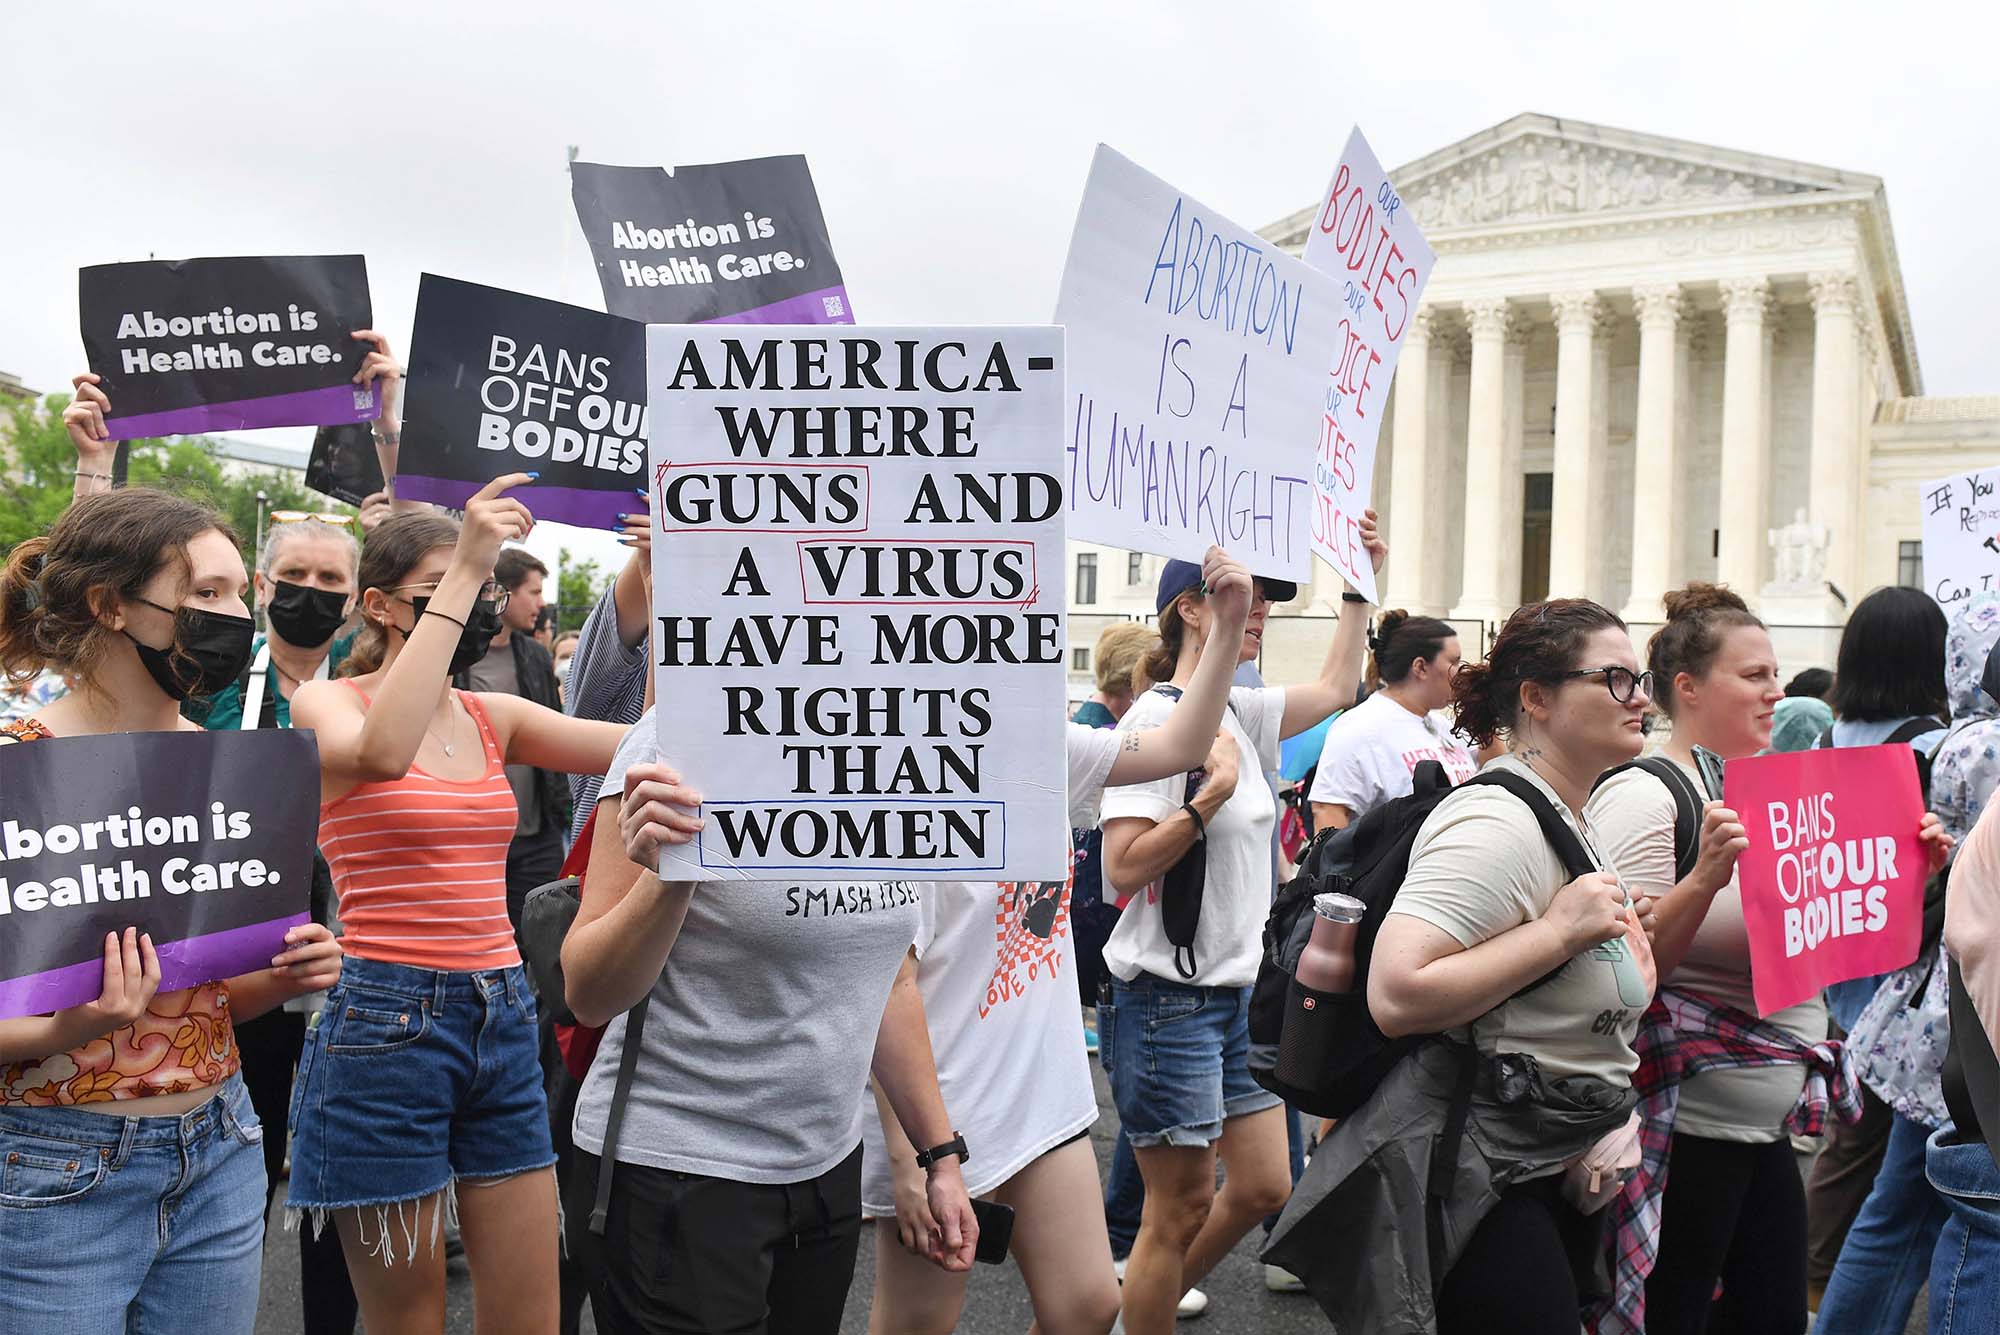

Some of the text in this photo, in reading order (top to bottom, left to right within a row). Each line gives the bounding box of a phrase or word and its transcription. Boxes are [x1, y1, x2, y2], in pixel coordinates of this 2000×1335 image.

[1377, 181, 1400, 225] OUR
[611, 211, 775, 251] Abortion is
[1320, 164, 1417, 342] BODIES
[618, 248, 805, 288] Health Care.
[1144, 197, 1303, 355] ABORTION
[116, 303, 318, 340] Abortion is
[120, 337, 343, 375] Health Care.
[488, 334, 611, 393] BANS
[1156, 333, 1248, 439] IS A
[477, 412, 646, 475] BODIES
[715, 406, 979, 458] WHERE
[665, 472, 1063, 525] GUNS AND
[1966, 474, 1994, 505] You
[721, 546, 1024, 600] A VIRUS
[658, 612, 1063, 667] HAVE MORE
[722, 686, 992, 737] RIGHTS
[782, 744, 985, 795] THAN
[0, 801, 252, 861] bortion is
[711, 808, 991, 859] WOMEN
[1767, 791, 1836, 851] BANS
[161, 857, 281, 895] Care.
[785, 885, 873, 918] SMASH
[1783, 884, 1889, 959] BODIES
[978, 972, 1025, 1020] LOVE
